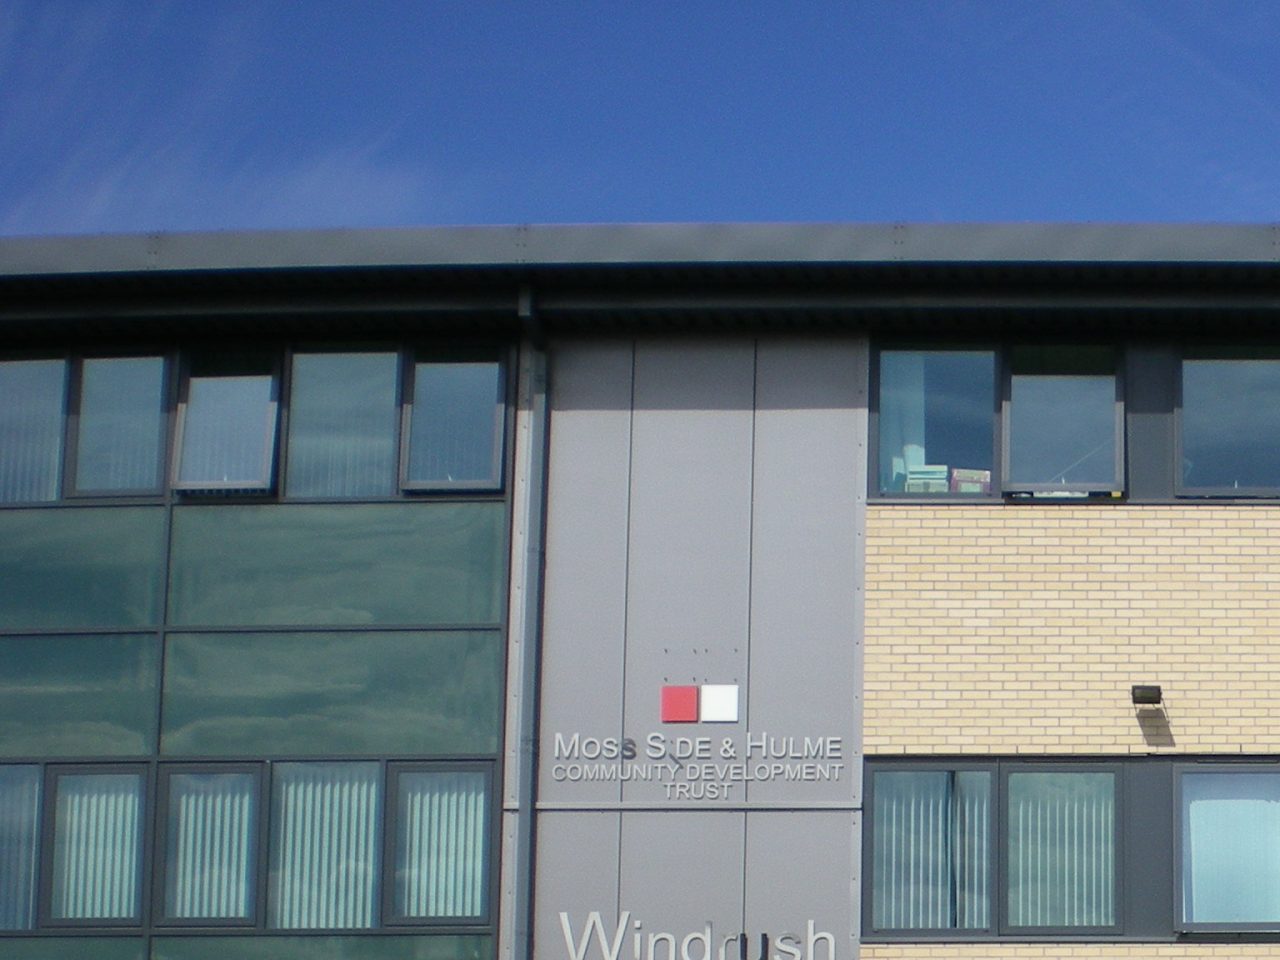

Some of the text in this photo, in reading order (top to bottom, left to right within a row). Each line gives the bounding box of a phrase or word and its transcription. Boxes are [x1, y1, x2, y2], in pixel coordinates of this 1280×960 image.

[554, 731, 637, 760] MOSS
[719, 736, 737, 760] &
[746, 731, 843, 760] HULME
[551, 763, 845, 781] COMMUNITY DEVELOPMENT
[663, 782, 734, 800] TRUST
